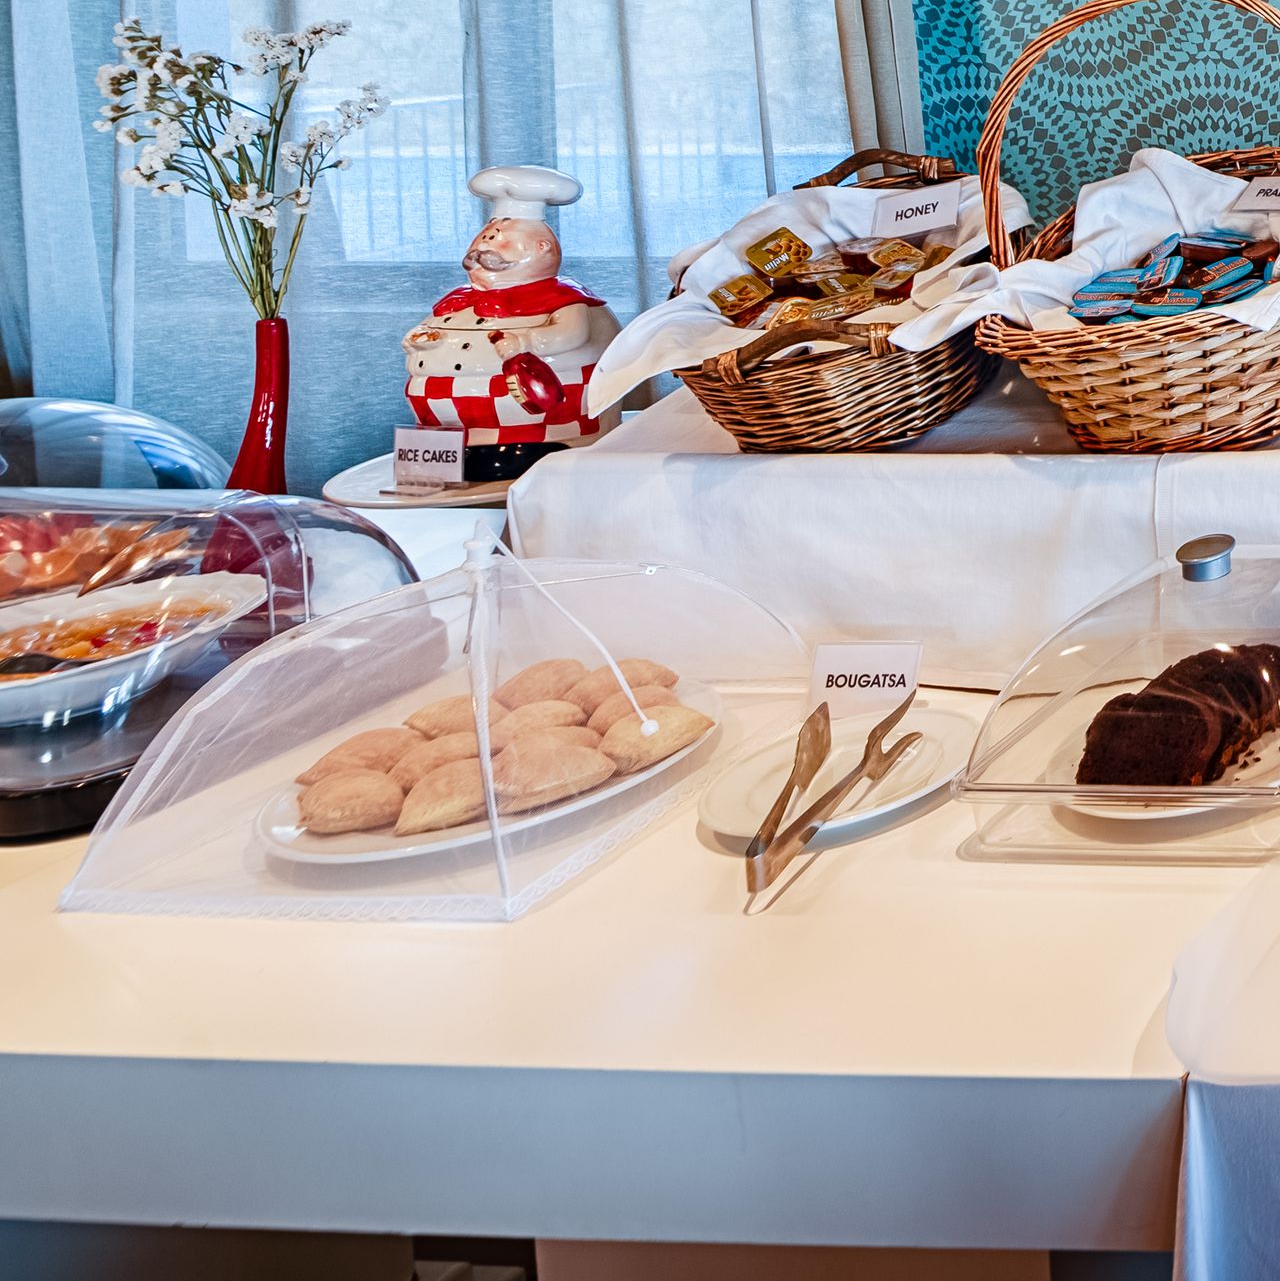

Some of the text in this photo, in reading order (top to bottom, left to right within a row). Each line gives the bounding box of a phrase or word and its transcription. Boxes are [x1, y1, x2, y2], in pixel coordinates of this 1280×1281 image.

[895, 201, 939, 222] HONEY
[398, 448, 458, 463] RICE CAKES
[825, 673, 907, 688] BOUGATSA
